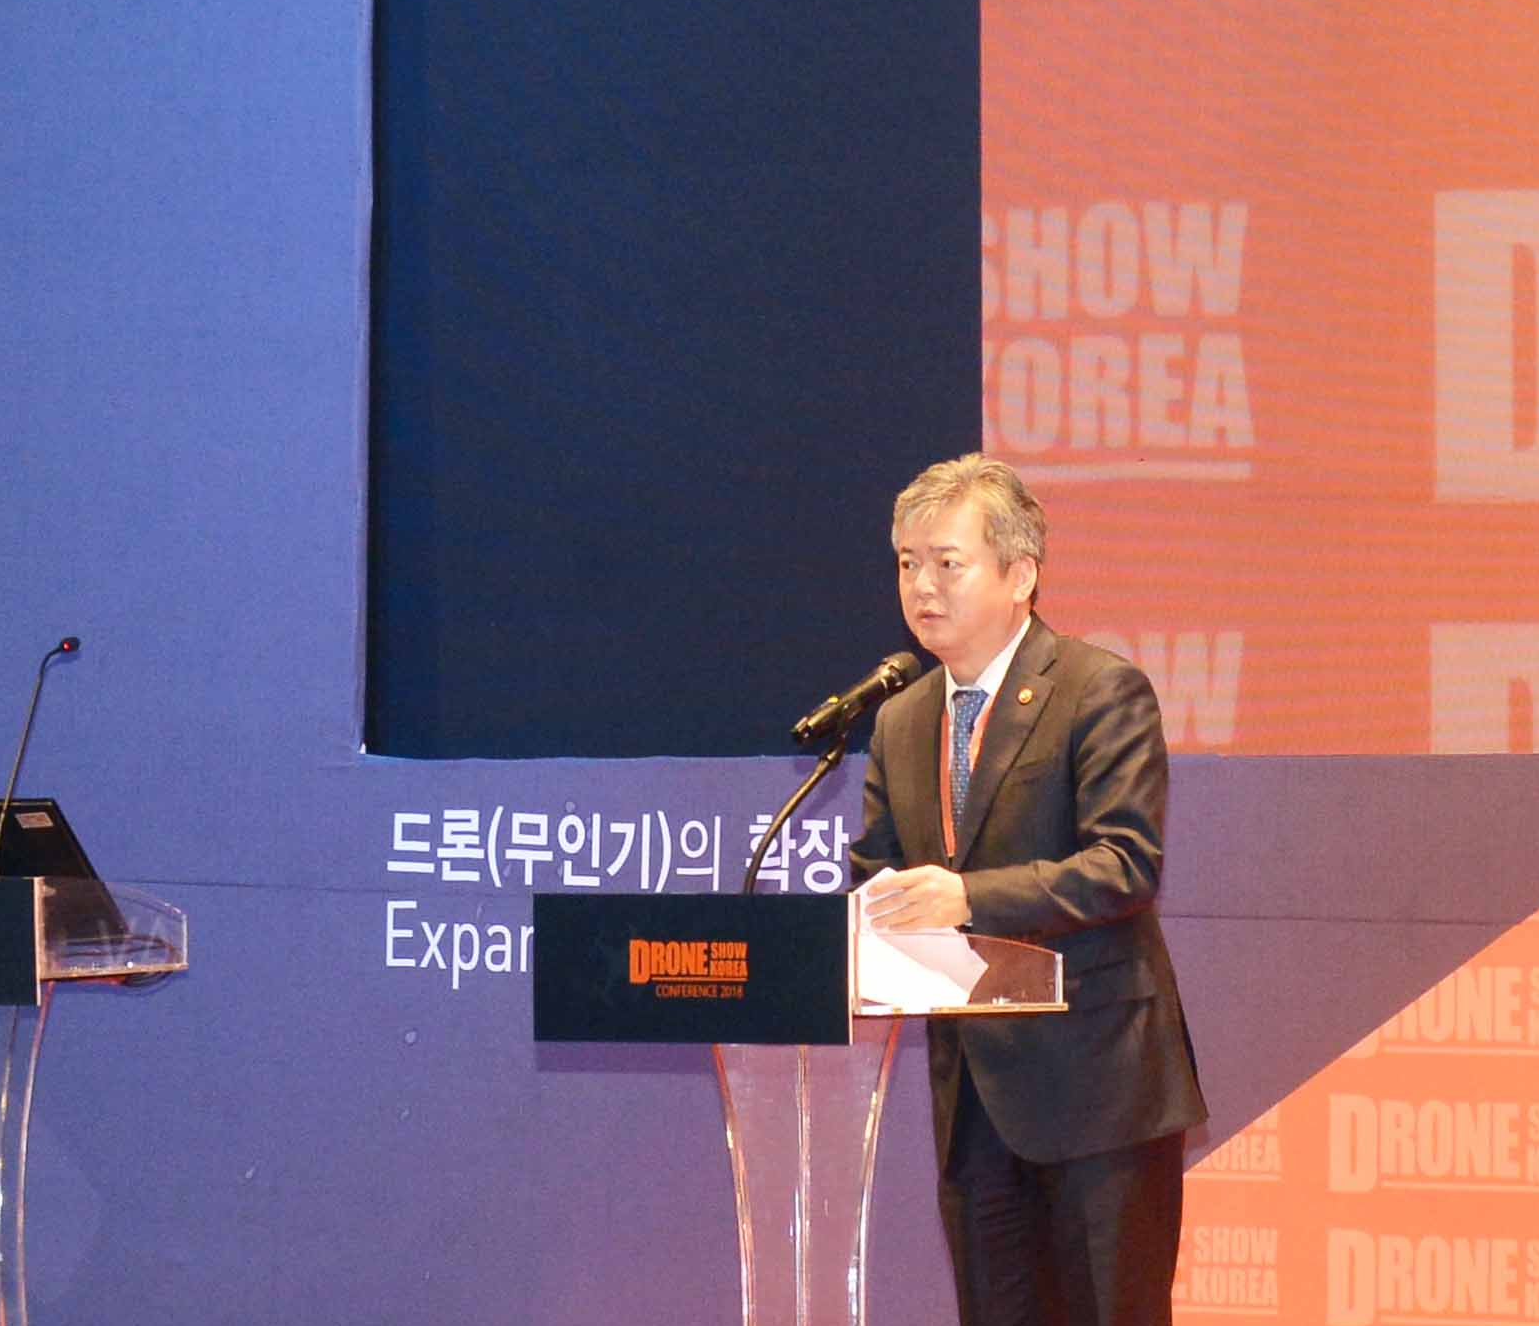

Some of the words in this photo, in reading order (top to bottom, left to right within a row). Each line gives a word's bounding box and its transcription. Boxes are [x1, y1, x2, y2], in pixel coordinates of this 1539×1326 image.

[982, 332, 1256, 455] OREA
[387, 805, 722, 892] 드론(무인기)의
[629, 939, 708, 984] DRONE
[711, 942, 748, 959] SHOW
[710, 960, 748, 977] KOREA
[1327, 1093, 1520, 1192] DRONE
[1193, 1226, 1279, 1266] SHOW
[1191, 1267, 1279, 1307] KOREA
